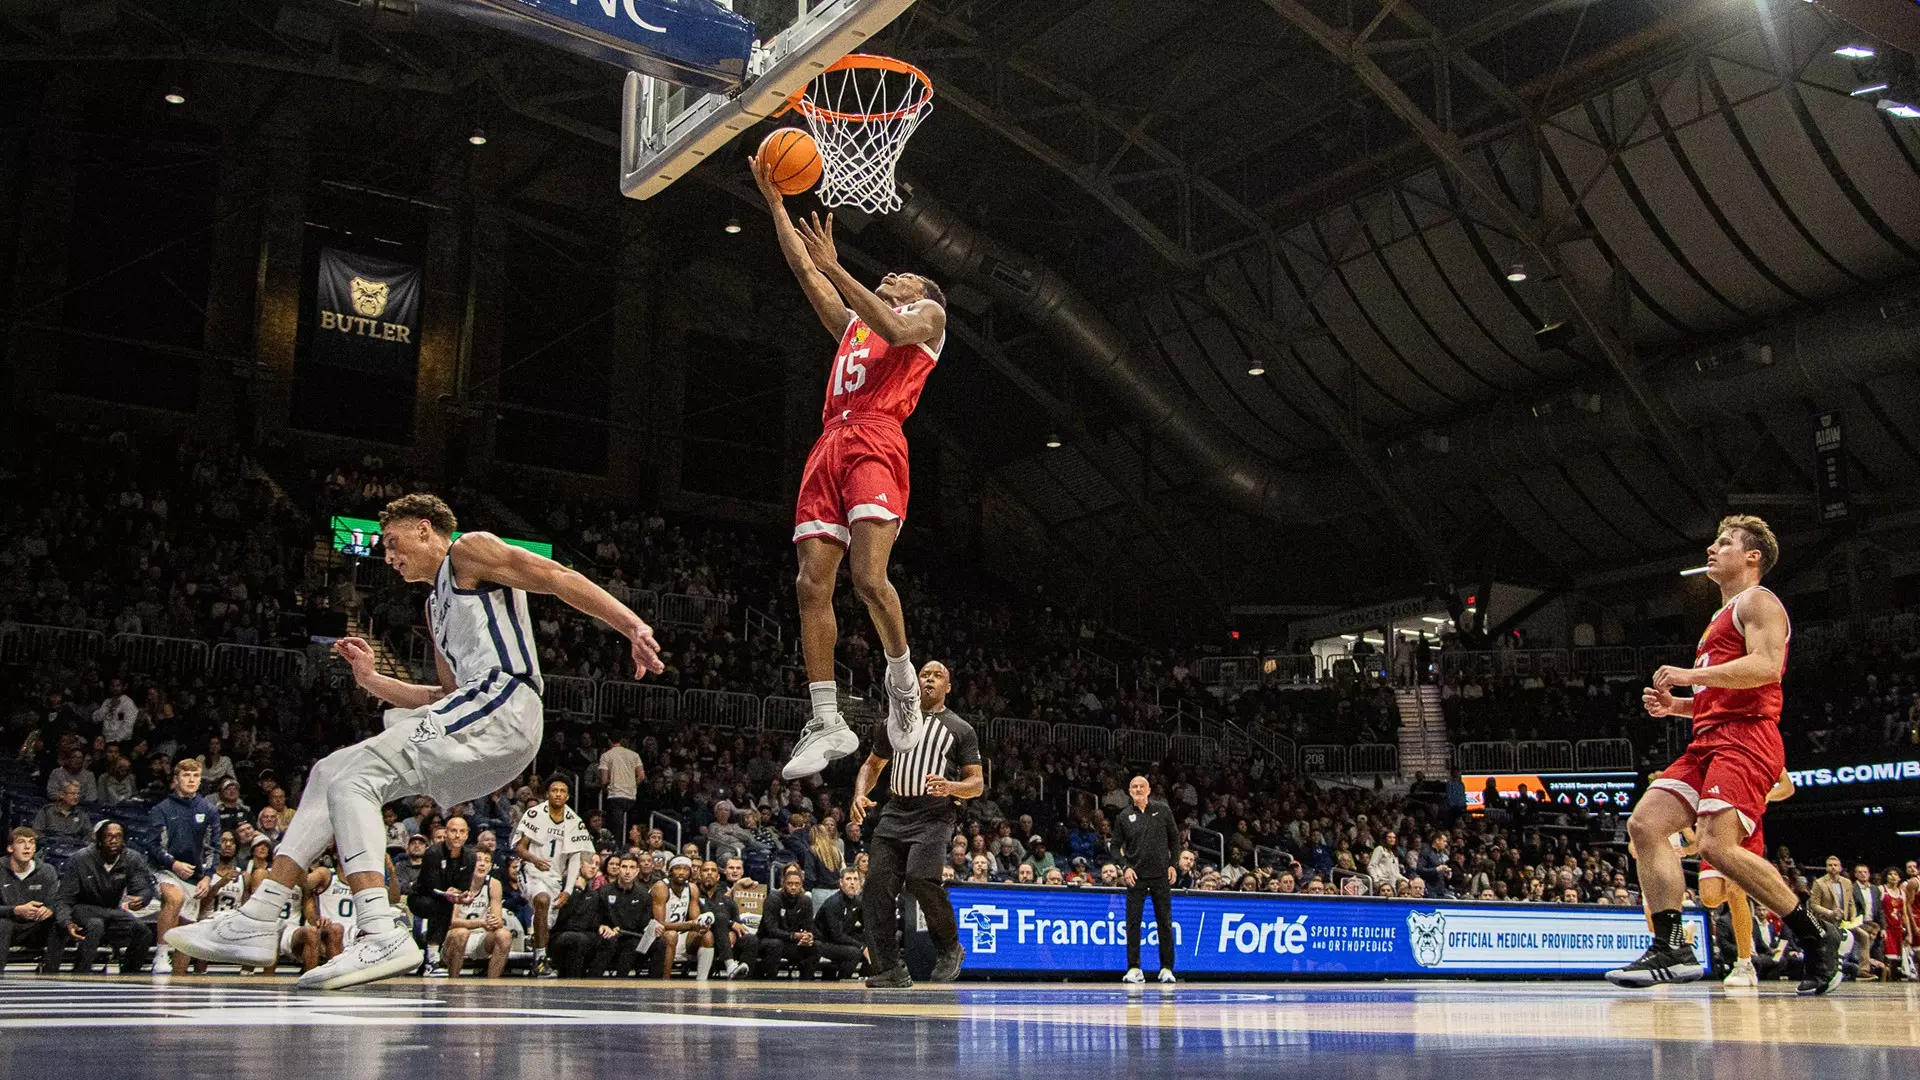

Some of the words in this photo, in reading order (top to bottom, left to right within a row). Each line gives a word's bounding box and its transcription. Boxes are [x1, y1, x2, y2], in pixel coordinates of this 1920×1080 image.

[320, 310, 411, 345] BUTLER
[833, 347, 871, 396] 15
[549, 839, 557, 858] 1
[338, 898, 353, 918] 0
[1218, 912, 1308, 954] Forté
[1311, 926, 1348, 938] SPORTS
[1352, 927, 1396, 939] MEDICINE
[1448, 931, 1494, 948] OFFICIAL
[1497, 932, 1538, 949] MEDICAL
[1542, 933, 1594, 949] PROVIDERS
[1596, 933, 1614, 949] FOR
[1617, 934, 1650, 950] BUTLER
[1328, 940, 1393, 952] ORTHOPEDICS
